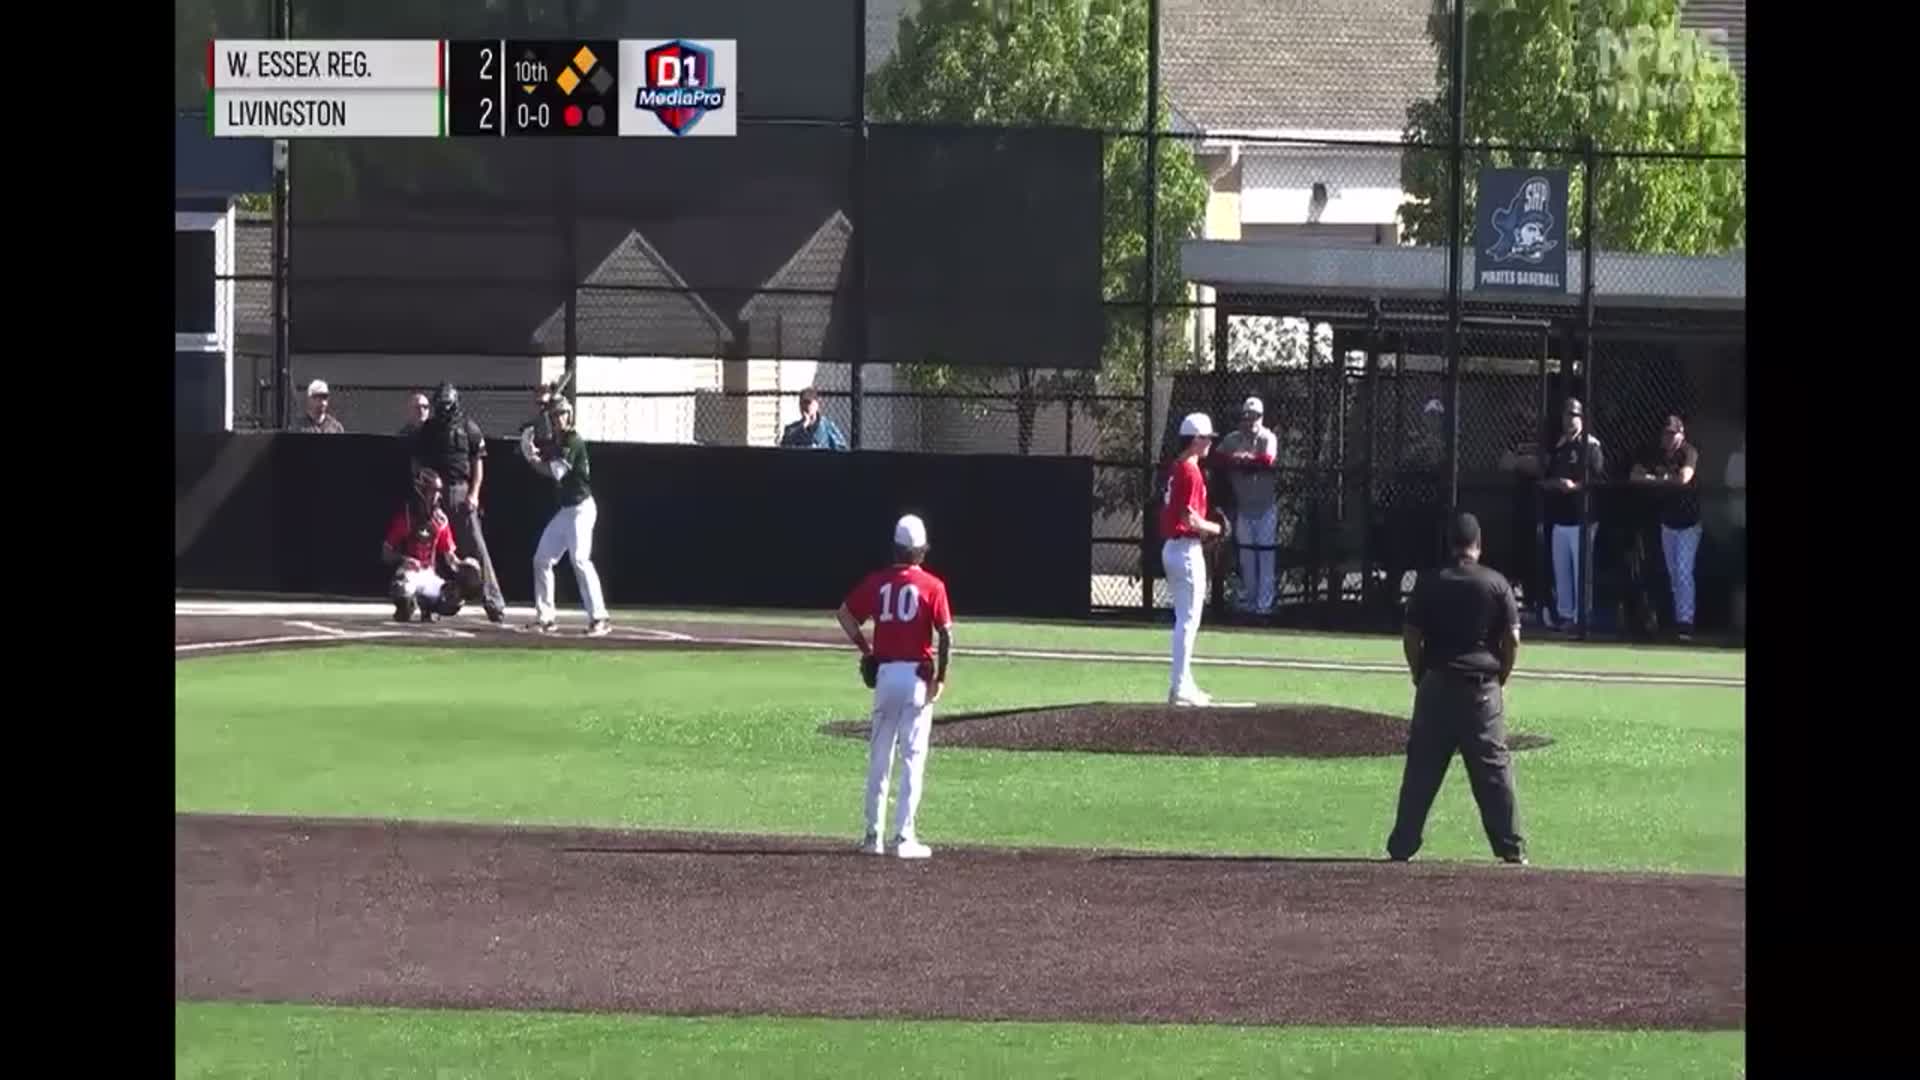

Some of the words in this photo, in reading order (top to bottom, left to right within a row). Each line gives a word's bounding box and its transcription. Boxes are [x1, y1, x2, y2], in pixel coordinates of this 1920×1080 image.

[1481, 270, 1515, 285] PIRATES
[1517, 271, 1560, 287] BASEBALL
[879, 583, 919, 622] 10
